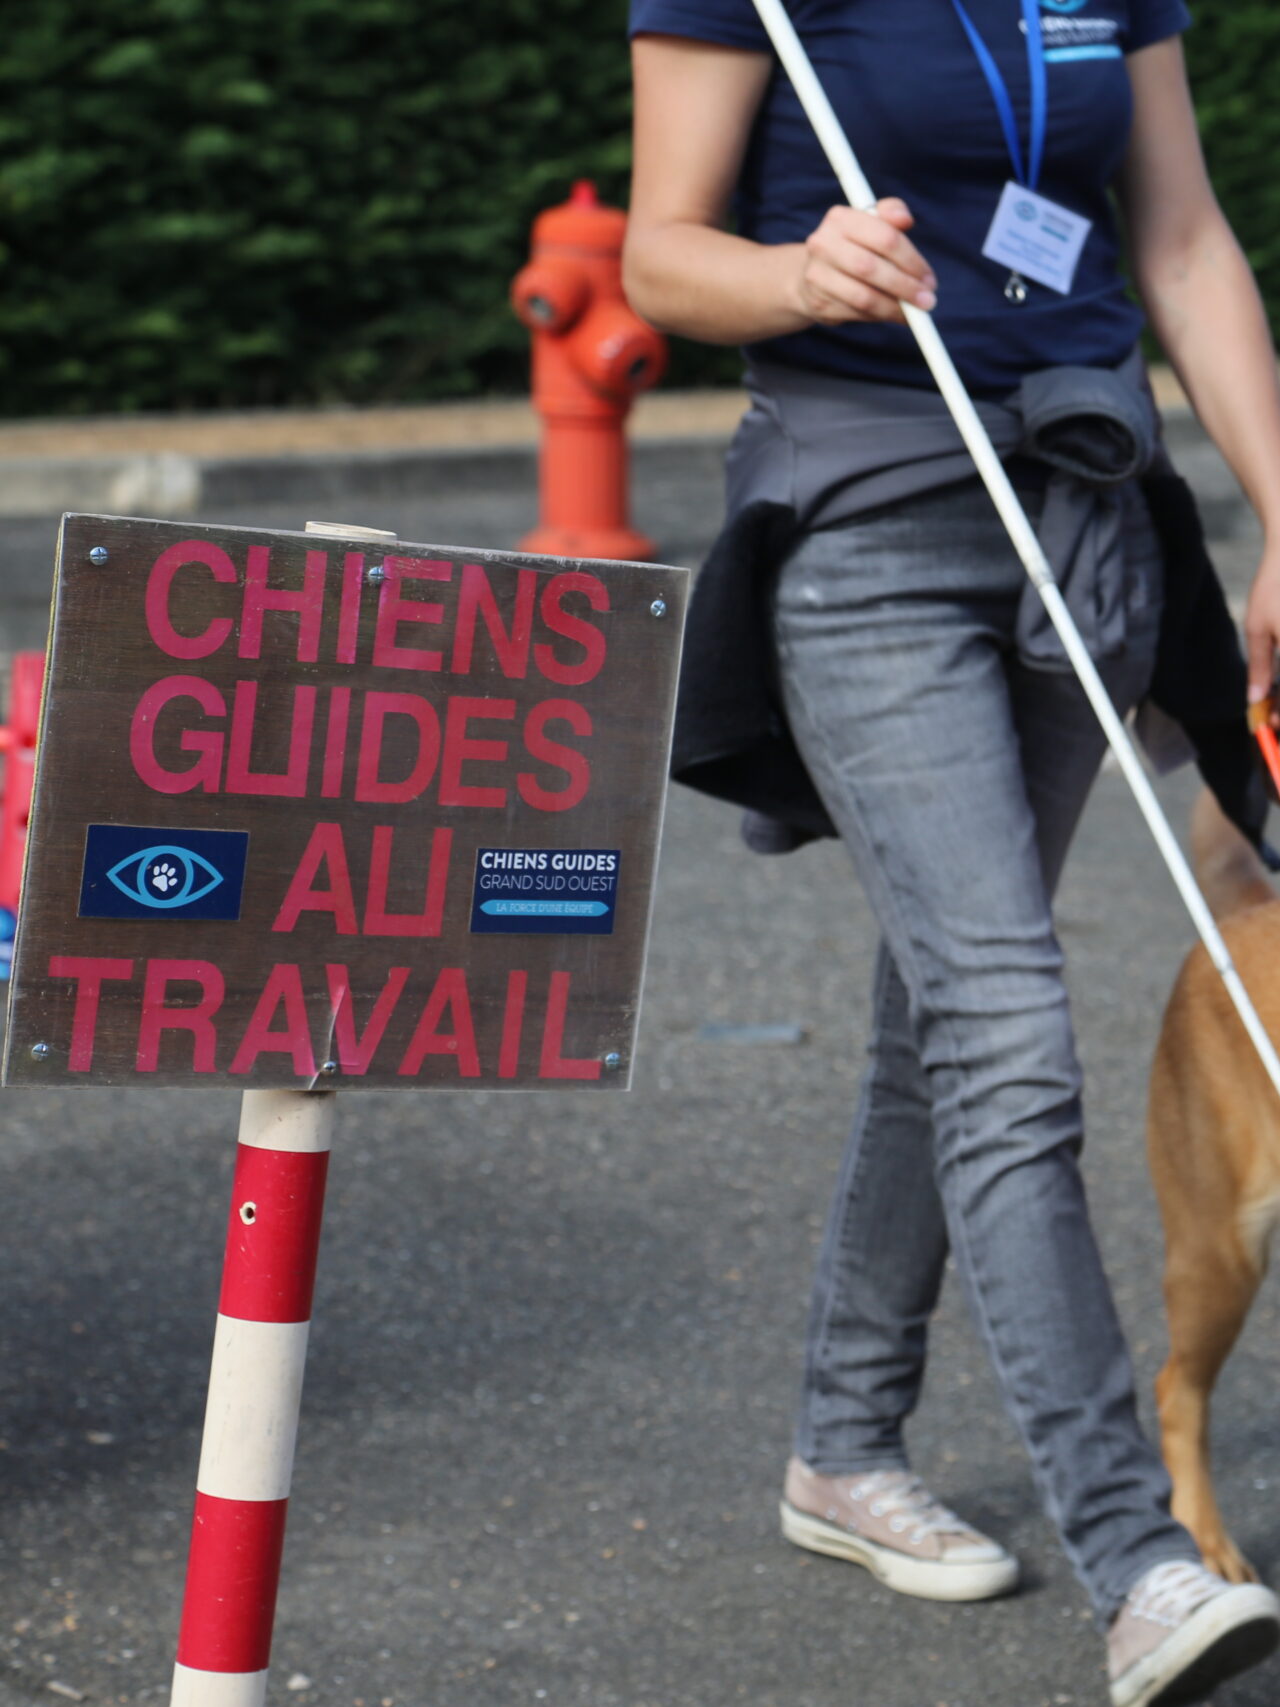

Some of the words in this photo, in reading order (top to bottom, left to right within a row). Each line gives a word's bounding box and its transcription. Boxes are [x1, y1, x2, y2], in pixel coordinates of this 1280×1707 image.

[145, 539, 610, 686] CHIENS
[129, 674, 593, 812] GUIDES
[271, 822, 454, 937] AU
[480, 874, 533, 890] GRAND
[535, 875, 566, 891] SUD
[568, 876, 616, 891] OUEST
[481, 852, 547, 870] CHIENS
[551, 853, 616, 871] GUIDES
[48, 956, 601, 1080] TRAVAIL
